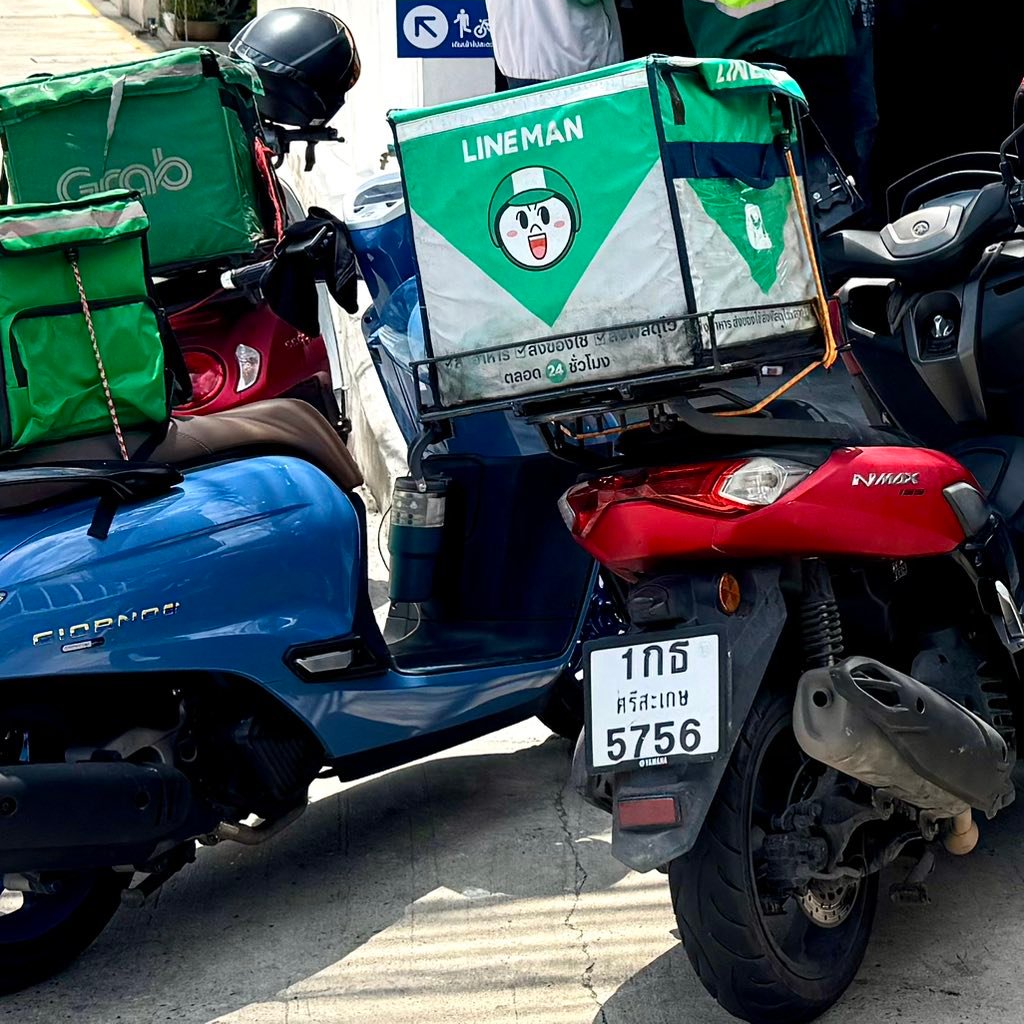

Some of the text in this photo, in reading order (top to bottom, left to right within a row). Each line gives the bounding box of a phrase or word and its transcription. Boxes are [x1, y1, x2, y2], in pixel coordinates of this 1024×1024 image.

[56, 147, 193, 203] Grab
[504, 353, 611, 385] ตลอด 24 ชั่วโมง
[852, 472, 920, 487] NMAX
[621, 640, 690, 681] 1กธ
[617, 688, 689, 715] ศรีสะเกษ
[607, 718, 702, 762] 5756
